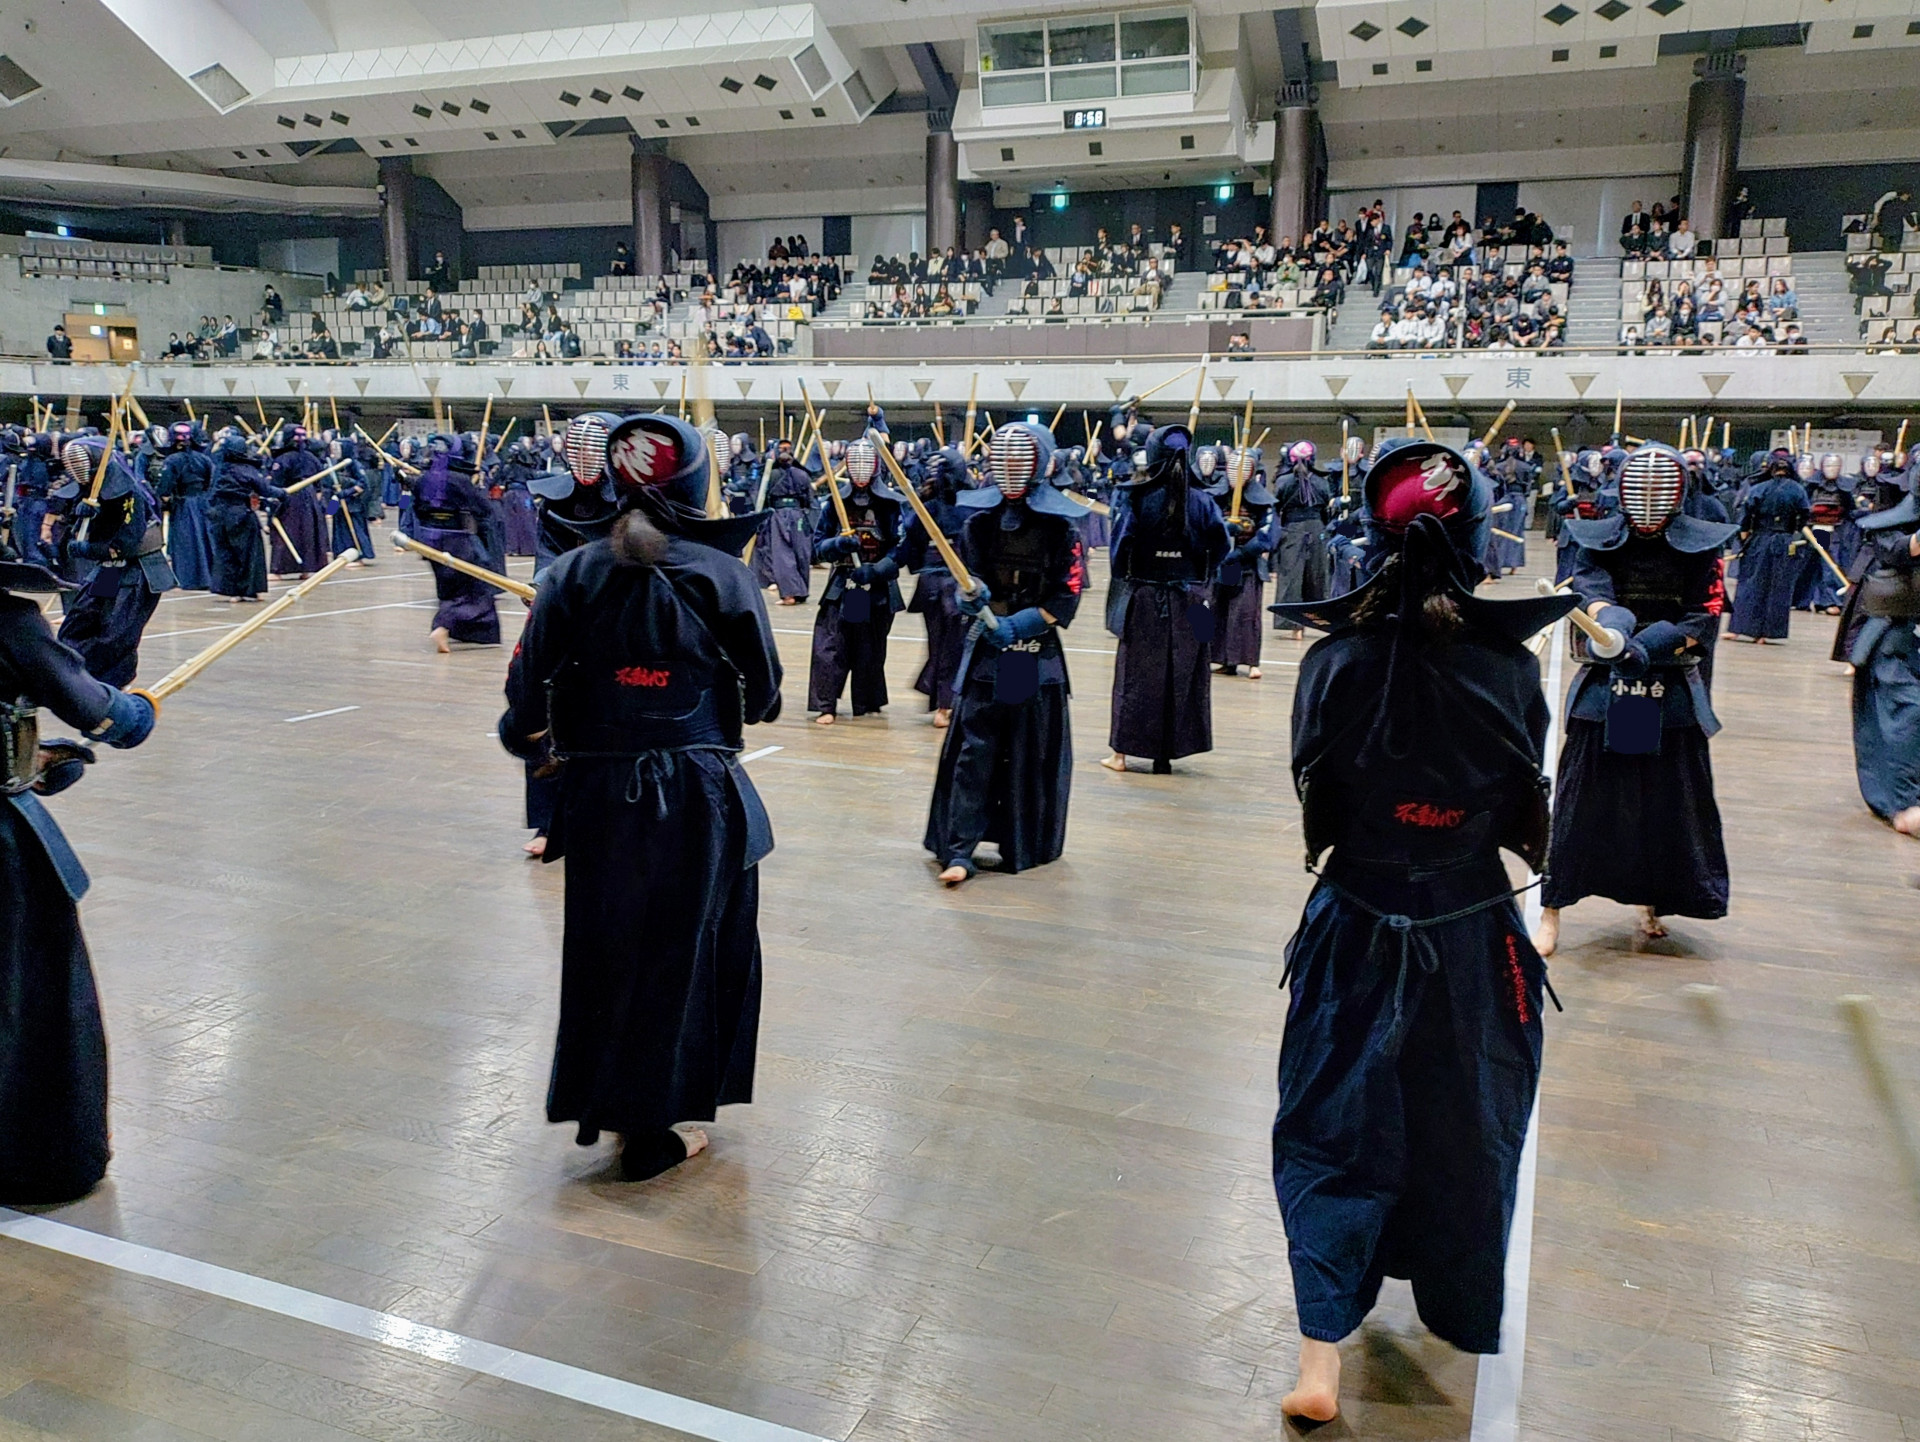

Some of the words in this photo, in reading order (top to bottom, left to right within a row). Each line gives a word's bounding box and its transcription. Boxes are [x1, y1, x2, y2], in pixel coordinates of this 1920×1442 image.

[1074, 110, 1103, 127] 8:58
[612, 373, 630, 391] 東
[1505, 366, 1532, 389] 東
[1611, 679, 1665, 698] 小山台
